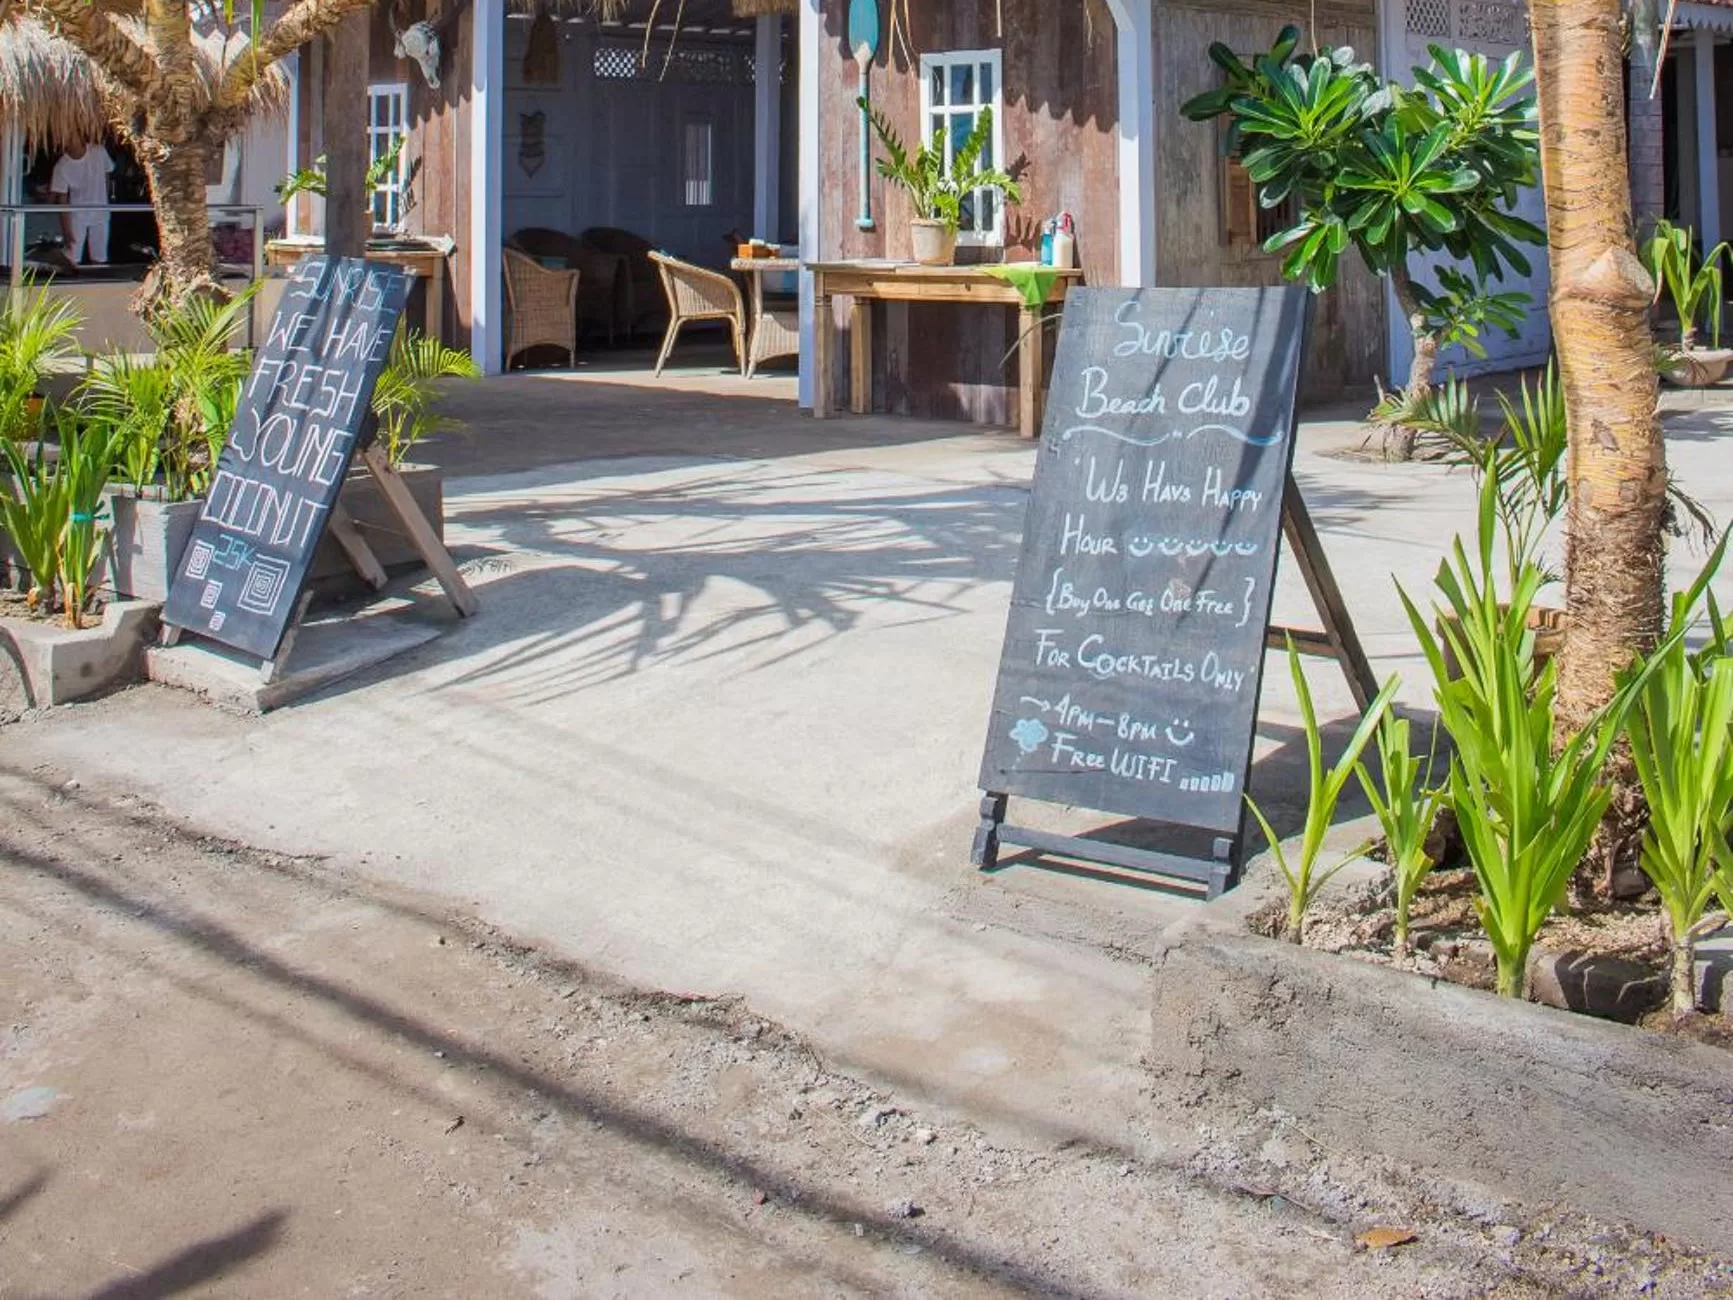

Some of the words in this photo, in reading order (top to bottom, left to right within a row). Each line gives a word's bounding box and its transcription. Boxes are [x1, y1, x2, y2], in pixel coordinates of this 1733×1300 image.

[266, 310, 317, 352] WE
[322, 317, 393, 362] HAVE
[1113, 300, 1250, 362] Sunrise
[247, 357, 366, 425] FRESH
[1076, 366, 1166, 418] Beach
[1178, 374, 1250, 416] Club
[232, 408, 354, 487] YOUNG
[200, 469, 329, 548] COCONUT
